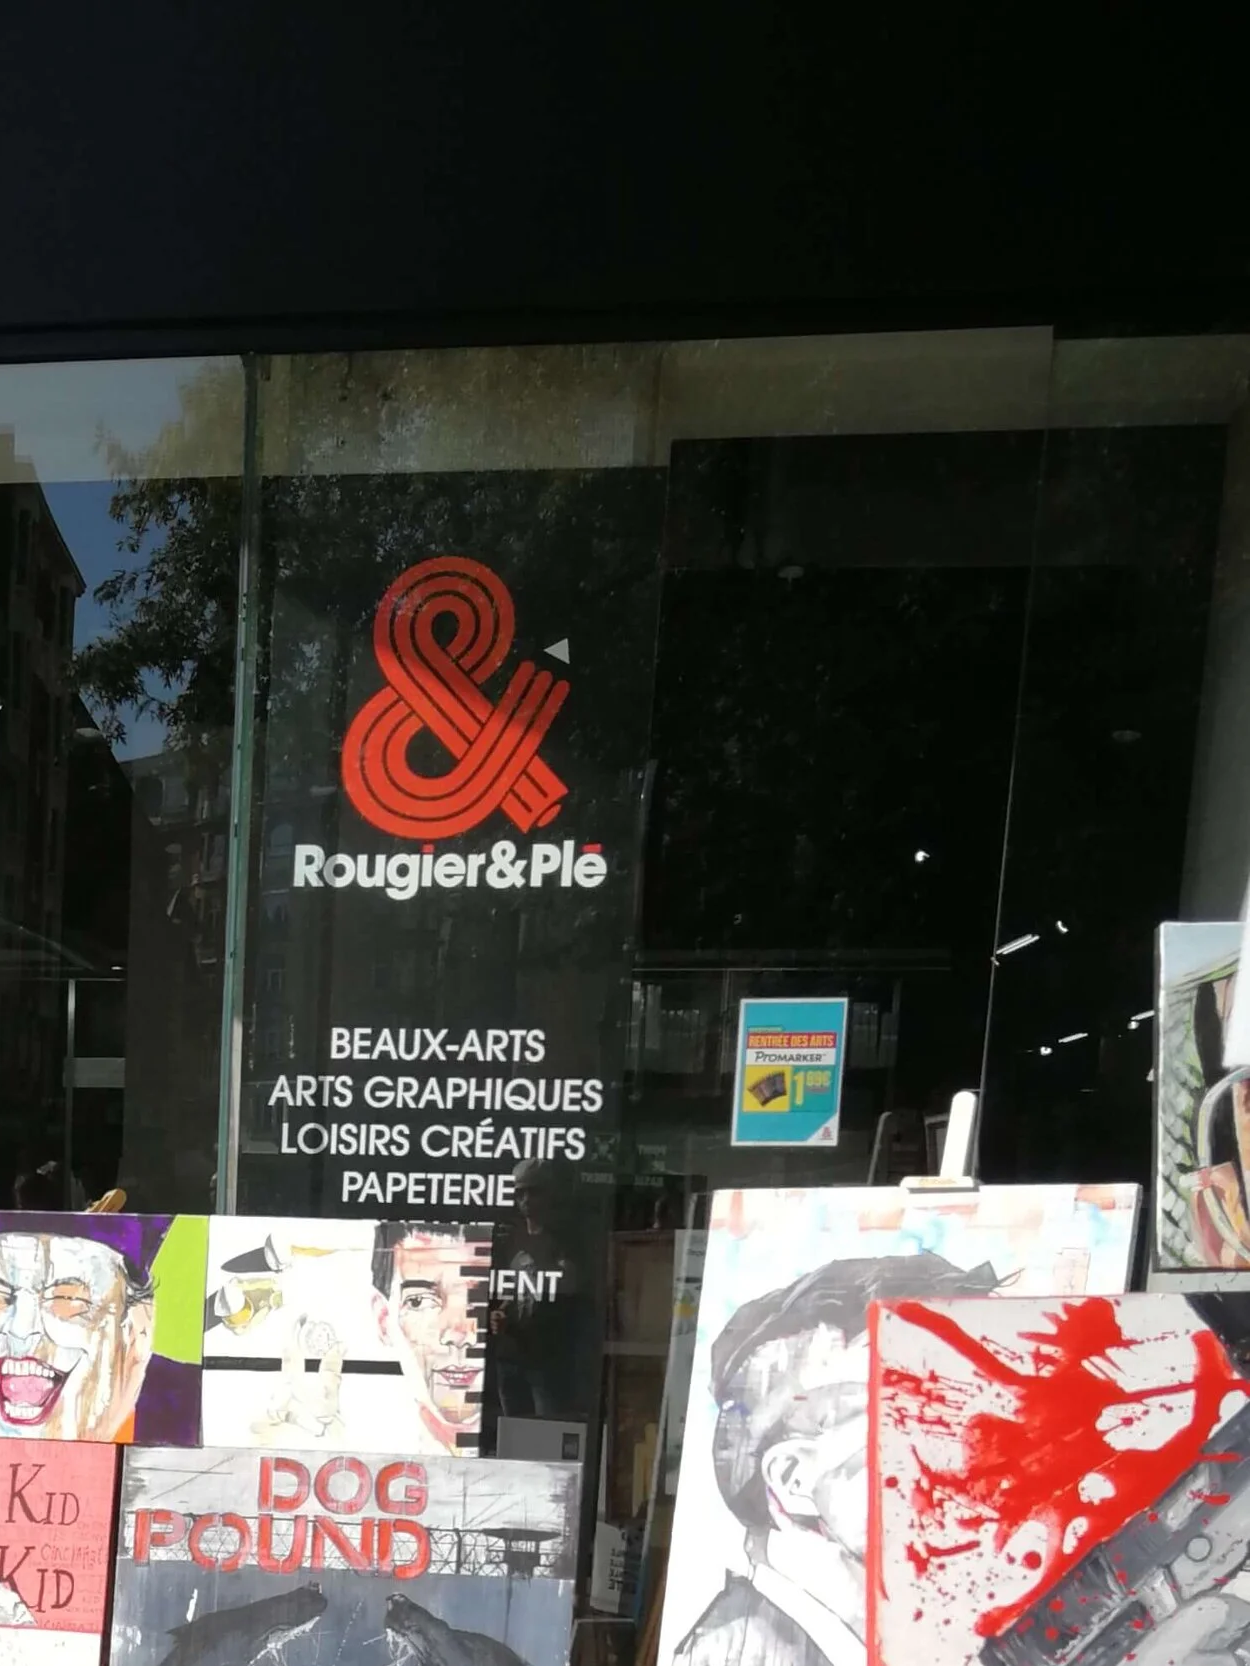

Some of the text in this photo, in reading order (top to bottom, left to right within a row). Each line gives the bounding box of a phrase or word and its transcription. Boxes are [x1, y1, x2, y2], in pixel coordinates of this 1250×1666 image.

[330, 1027, 547, 1064] BEAUX-ARTS
[791, 1035, 807, 1047] DES
[809, 1035, 834, 1047] ARTS
[268, 1075, 604, 1113] ARTS GRAPHIQUES
[280, 1117, 586, 1161] LOISIRS CRÉATIFS
[342, 1170, 516, 1207] PAPETERIE
[258, 1456, 429, 1516] DOG
[132, 1507, 431, 1580] POUND
